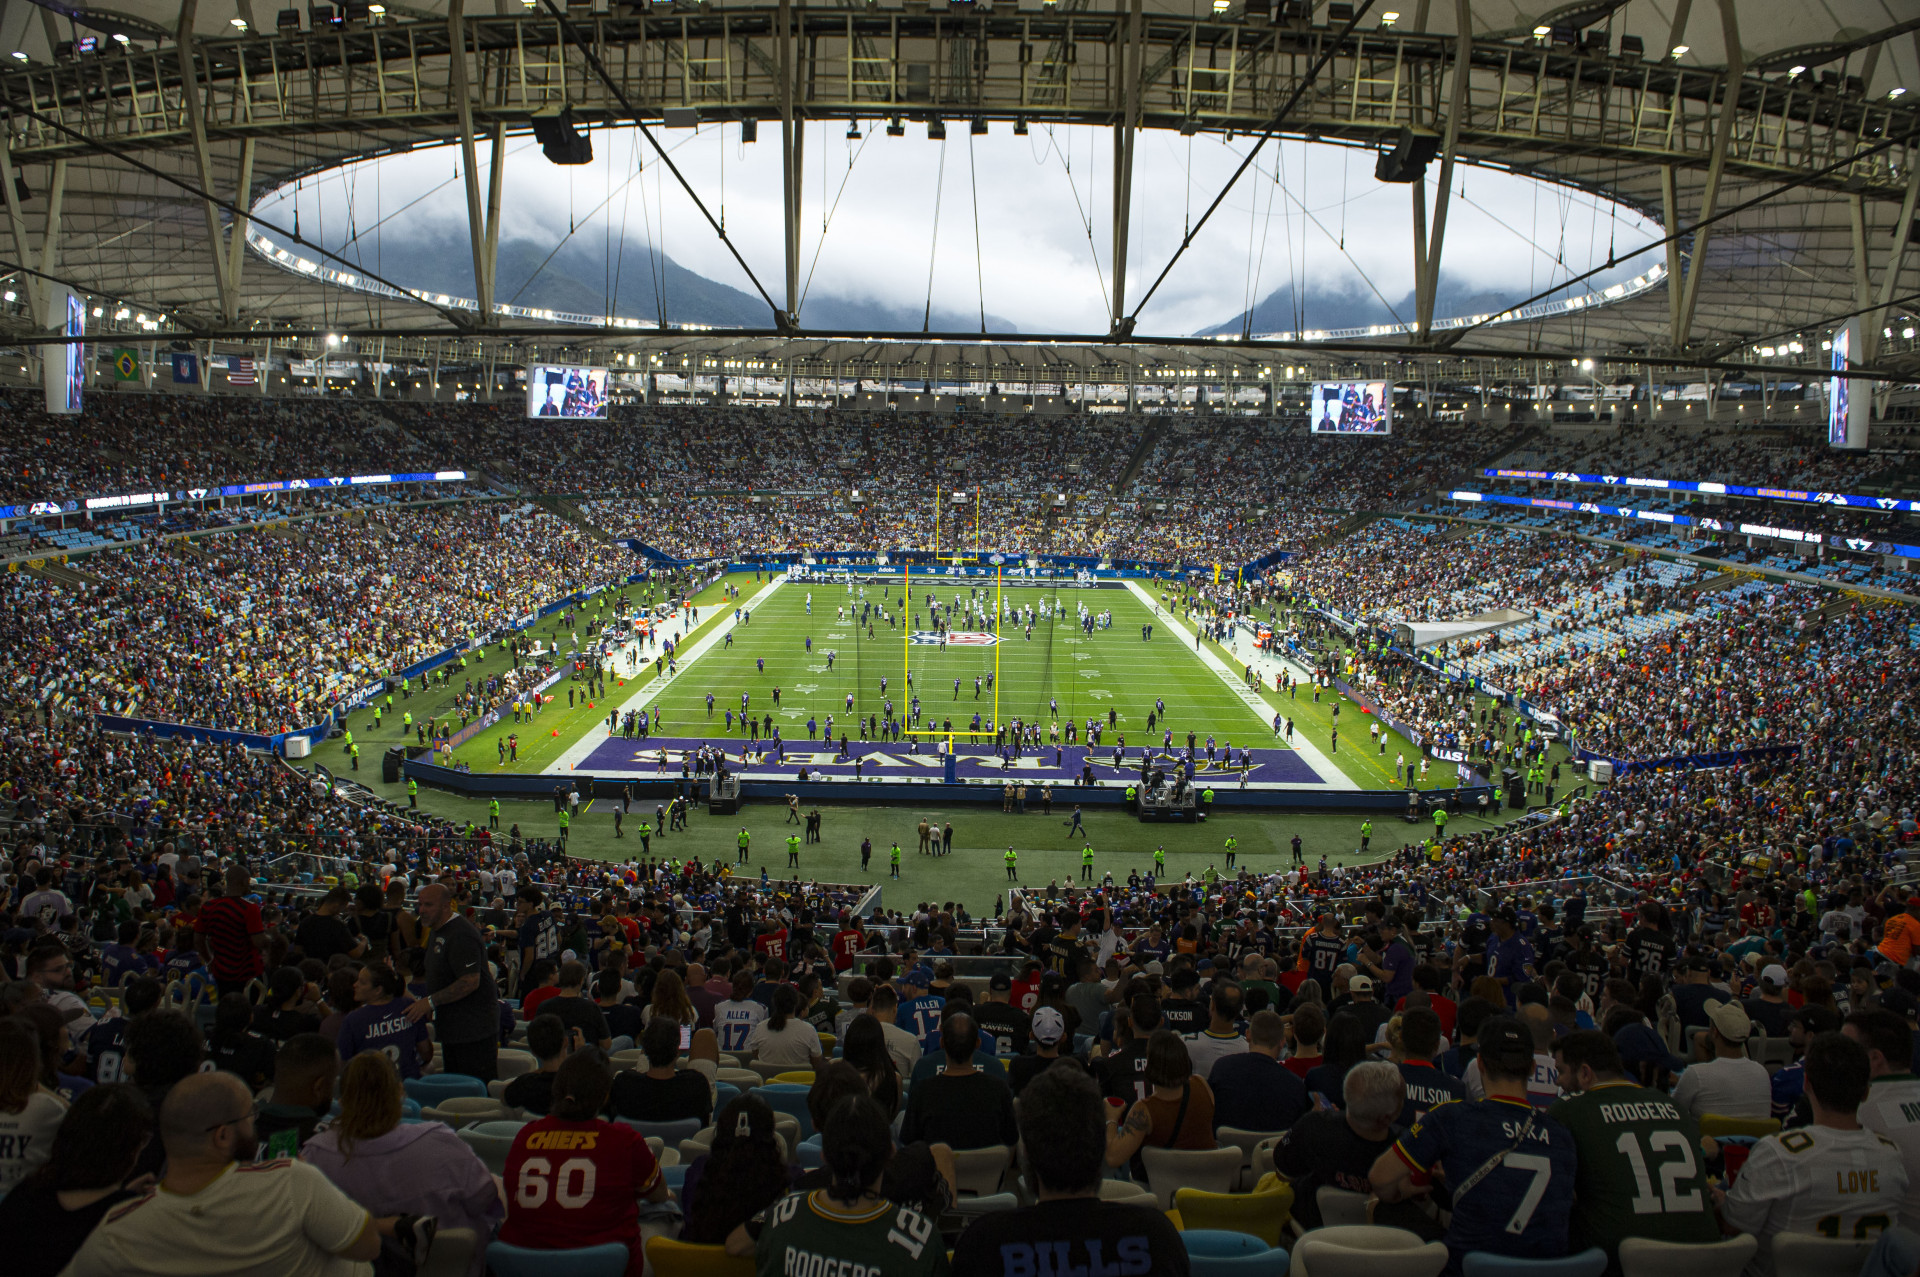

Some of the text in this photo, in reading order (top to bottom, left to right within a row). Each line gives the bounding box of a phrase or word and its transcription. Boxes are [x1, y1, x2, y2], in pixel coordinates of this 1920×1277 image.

[767, 943, 783, 957] 15
[844, 939, 858, 955] 15
[1315, 950, 1337, 972] 87
[1487, 954, 1497, 978] 8
[726, 1010, 751, 1020] ALLEN
[915, 999, 940, 1010] ALLEN
[913, 1009, 943, 1042] 17
[980, 1023, 1014, 1034] RAVENS
[722, 1023, 751, 1052] 17
[1406, 1083, 1452, 1105] WILSON
[1599, 1101, 1681, 1124] RODGERS
[525, 1130, 600, 1150] CHIEFS
[517, 1156, 597, 1210] 60
[1616, 1130, 1704, 1215] 12
[1837, 1170, 1881, 1195] LOVE
[1503, 1152, 1552, 1234] 7
[887, 1207, 933, 1261] 12
[1000, 1235, 1153, 1277] BILLS
